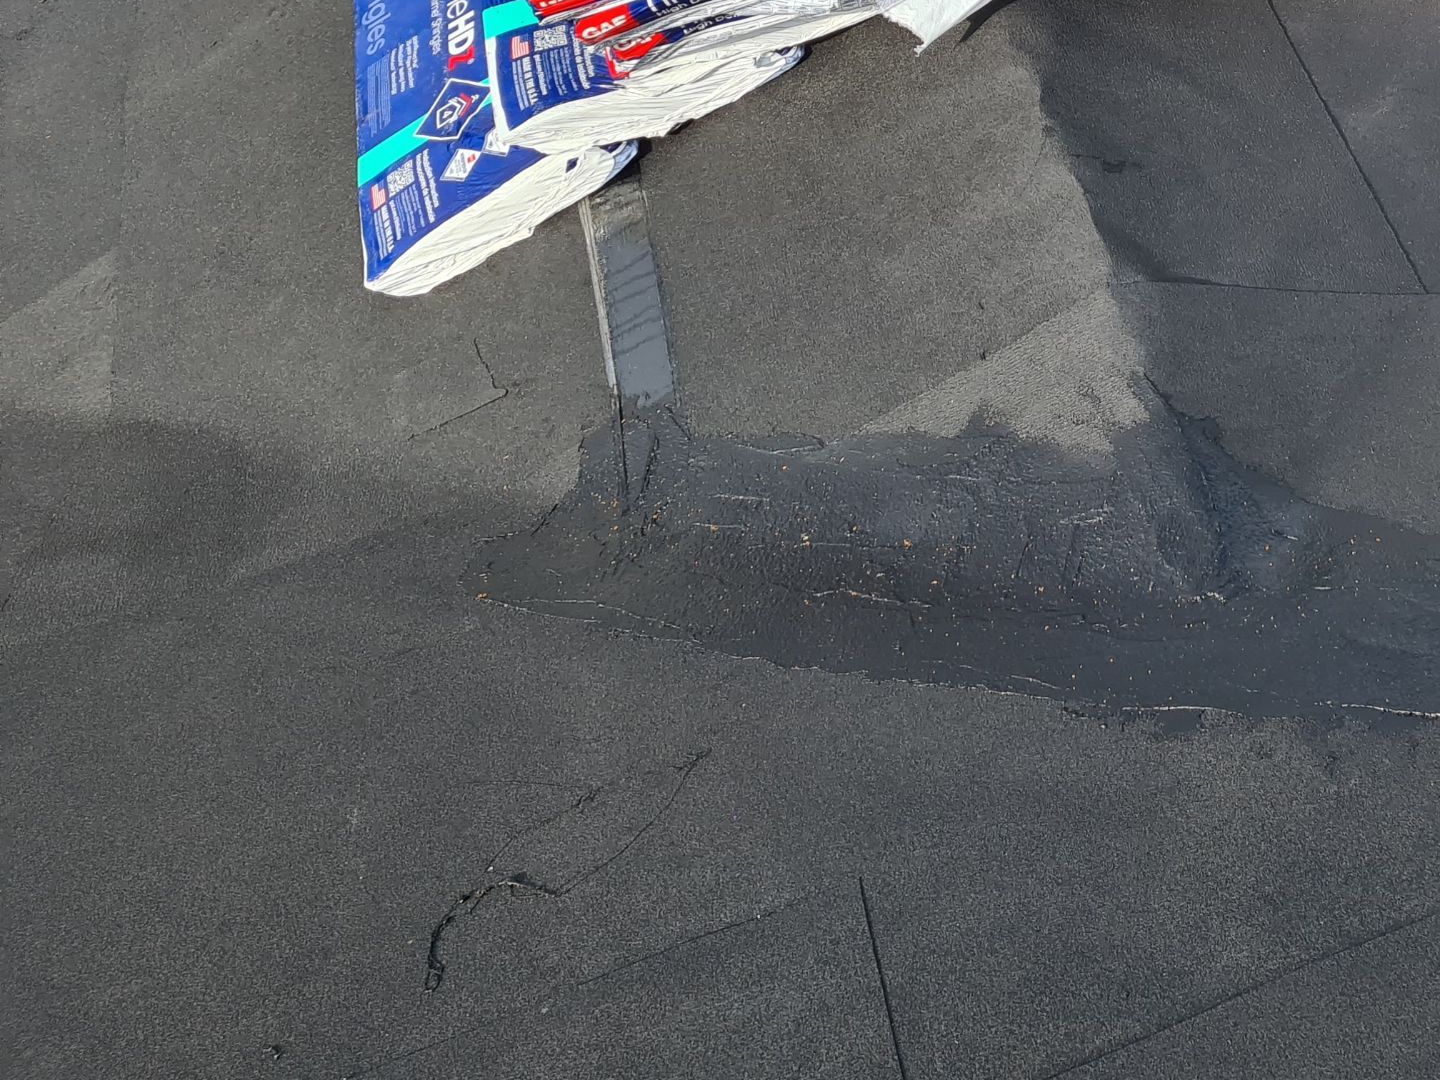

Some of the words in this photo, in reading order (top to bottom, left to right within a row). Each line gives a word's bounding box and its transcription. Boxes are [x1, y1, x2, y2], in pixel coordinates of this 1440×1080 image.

[431, 17, 442, 54] Shingles
[447, 12, 476, 71] HDZ
[582, 14, 627, 39] GAF
